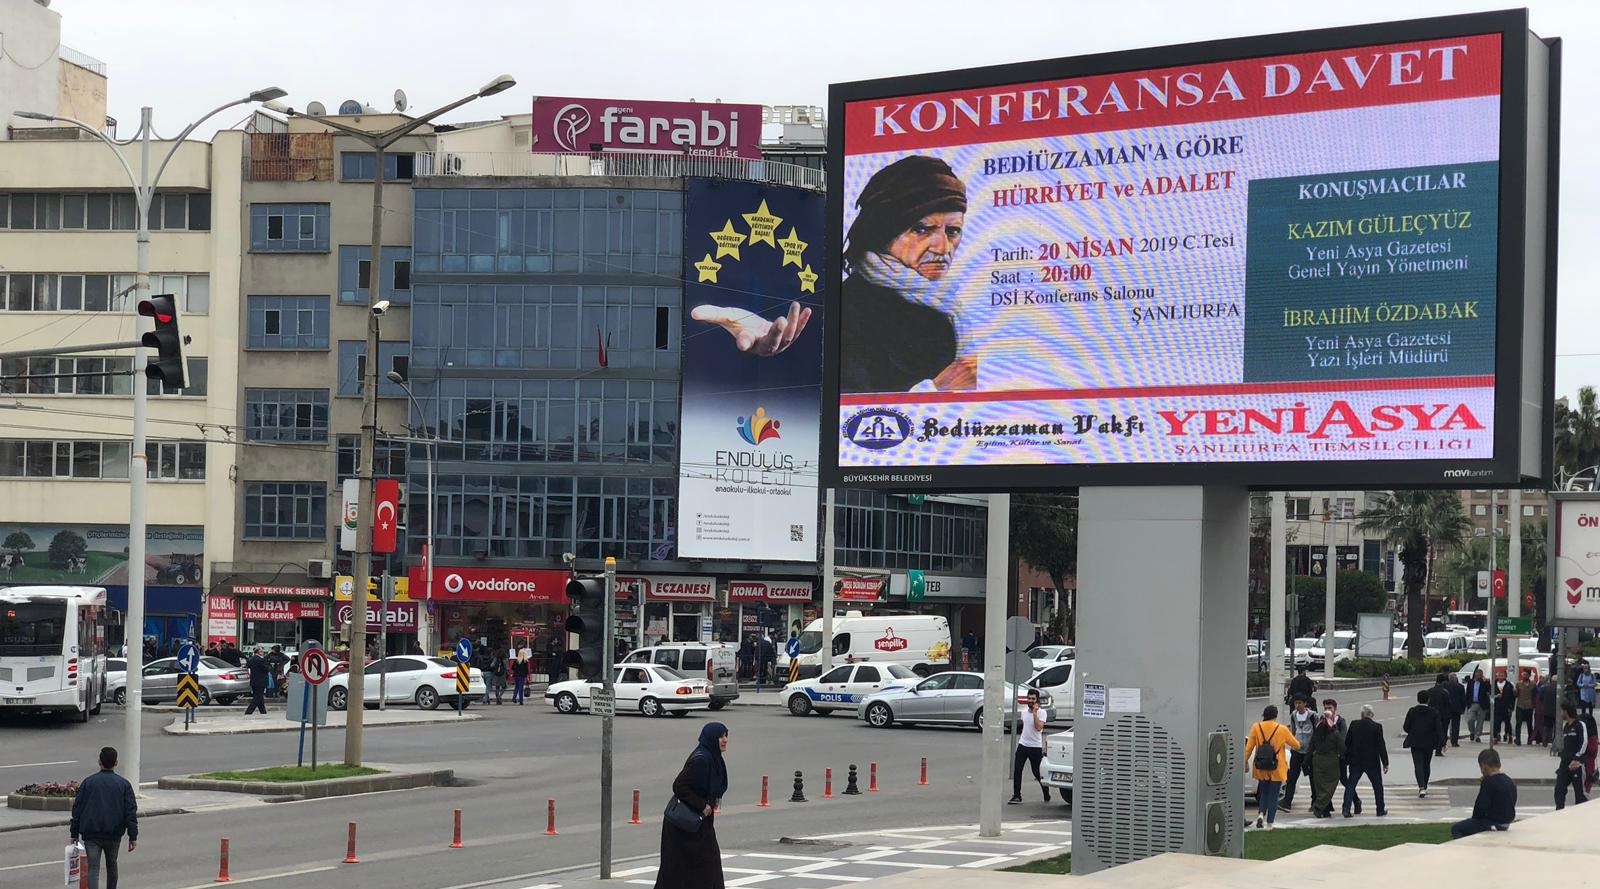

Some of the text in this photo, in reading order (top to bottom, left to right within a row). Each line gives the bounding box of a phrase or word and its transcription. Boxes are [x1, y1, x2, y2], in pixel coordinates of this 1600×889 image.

[873, 45, 1468, 137] KONFERANSA DAVET
[600, 106, 738, 147] farabi
[983, 135, 1244, 175] BEDİÜZZAMAN'A GÖRE
[992, 171, 1236, 208] HÜRRİYET ve ADALET
[1298, 172, 1467, 200] KONUŞMACILAR
[1288, 210, 1472, 240] KAZIM GÜLEÇYÜZ
[1038, 242, 1060, 261] 20
[1065, 235, 1134, 259] NİSAN
[1140, 237, 1178, 253] 2019
[1182, 233, 1235, 250] C.Tesi
[1306, 239, 1452, 262] Yeni Asya Gazetesi
[991, 270, 1021, 285] Saat
[1040, 264, 1092, 283] 20:00
[1288, 255, 1469, 280] Genel Yayın Yönetmeni
[991, 285, 1155, 306] DSİ Konferans Salonu
[1131, 303, 1240, 326] ŞANLIURFA
[1282, 301, 1480, 328] İBRAHİM ÖZDABAK
[1305, 330, 1451, 351] Yeni Asya Gazetesi
[1307, 349, 1449, 370] Yazı İşleri Müdürü
[916, 415, 1064, 443] Bediüzzaman
[1072, 413, 1145, 438] Vakfı
[1053, 437, 1082, 446] Sanat
[1175, 438, 1472, 455] ŞANLIURFA TEMSİLCİLİĞİ
[715, 450, 793, 470] ENDÜLÜS
[843, 473, 932, 484] BÜYÜKŞEHİR BELEDİYESİ
[233, 586, 325, 596] KUBAT TEKNİK SERVİS
[468, 578, 536, 592] vodafone
[656, 581, 711, 595] ECZANESİ
[732, 586, 810, 597] KONAK ECZANESİ
[925, 580, 941, 593] TEB
[211, 598, 235, 610] KUBAT
[247, 600, 291, 611] KUBAT
[300, 609, 320, 617] SERVİS
[271, 612, 294, 620] SERVİS
[820, 693, 842, 702] POLİS
